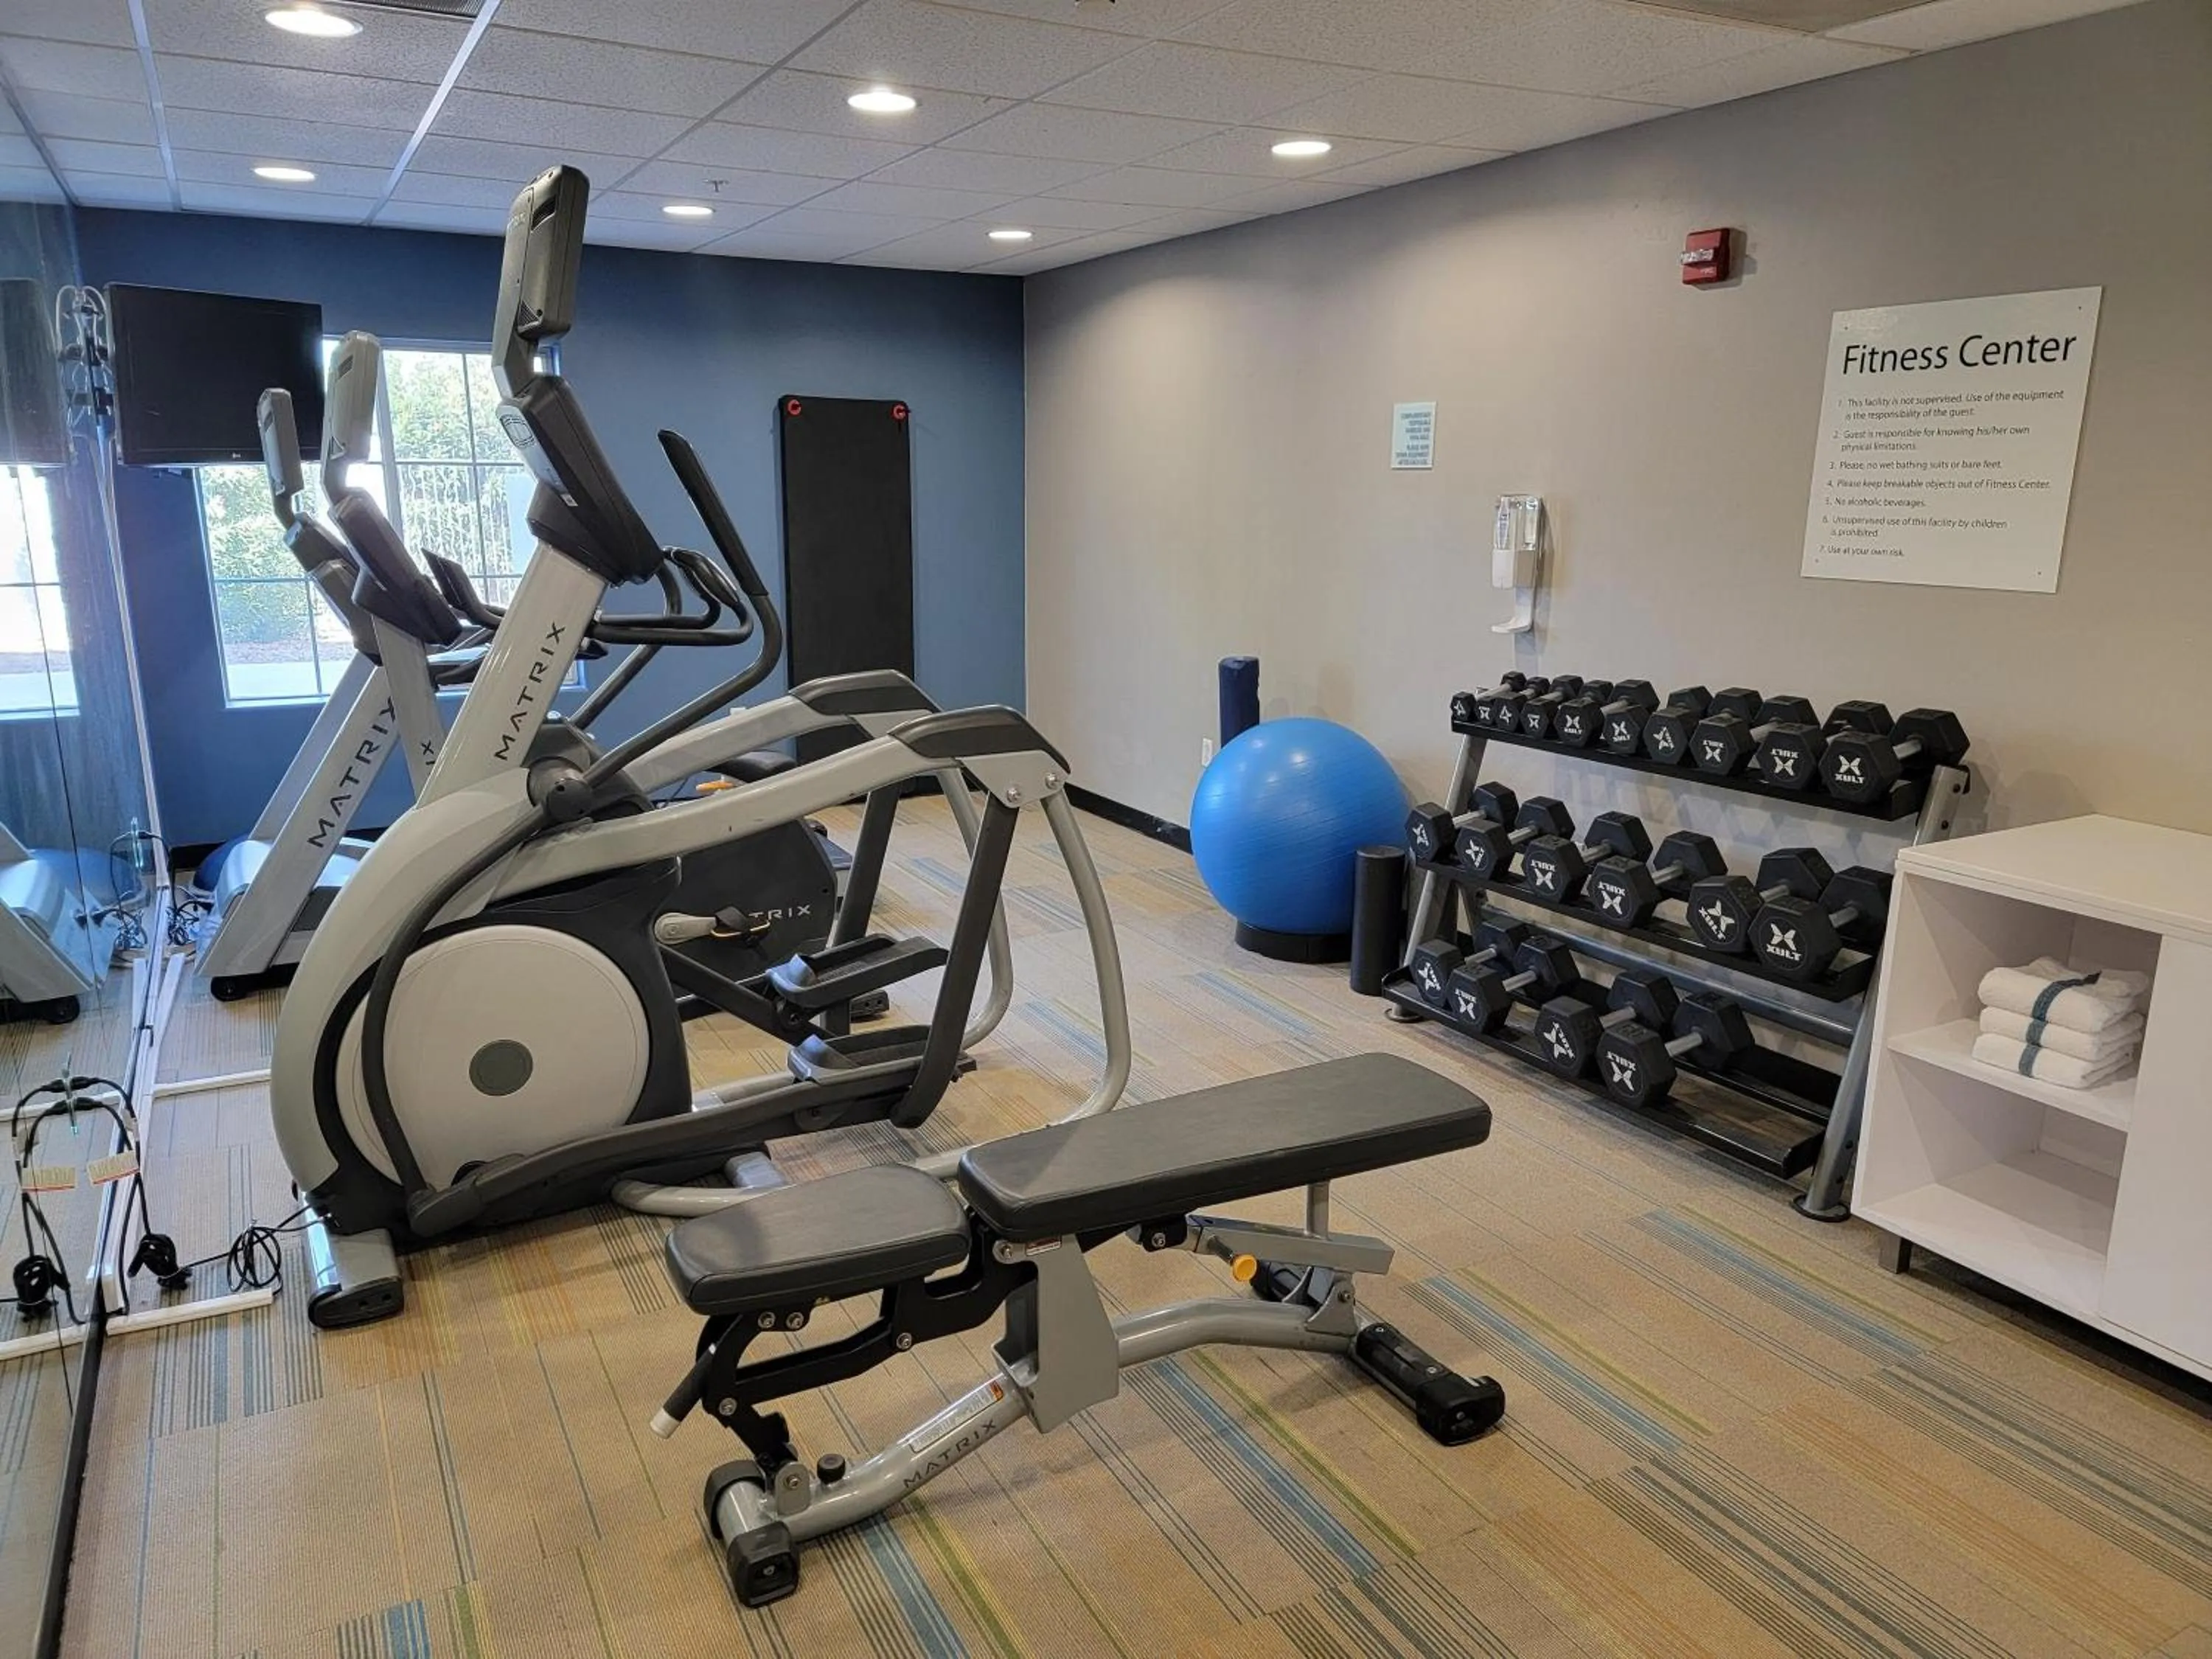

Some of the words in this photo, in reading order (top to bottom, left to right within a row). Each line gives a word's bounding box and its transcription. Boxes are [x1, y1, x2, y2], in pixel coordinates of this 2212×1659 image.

[1843, 344, 1949, 375] Fitness
[1959, 334, 2077, 367] Center
[1865, 397, 1891, 408] facility
[1901, 397, 1914, 405] not
[1966, 393, 1982, 403] Use
[1984, 392, 1994, 403] of
[1996, 392, 2011, 401] the
[2012, 390, 2064, 402] equipment
[1854, 411, 1866, 420] the
[1868, 409, 1920, 421] responsibility
[1922, 408, 1932, 418] of
[1933, 408, 1947, 417] the
[1843, 429, 1866, 439] Guest
[1876, 428, 1922, 439] responsible
[1924, 427, 1934, 437] for
[1937, 426, 1974, 438] knowing
[2010, 427, 2030, 435] own
[1841, 442, 1872, 453] physical
[1840, 460, 1864, 470] Please
[1879, 461, 1895, 470] wet
[1896, 460, 1927, 471] bathing
[1930, 460, 1948, 470] suits
[1961, 459, 1981, 469] bare
[1837, 479, 1862, 488] Please
[1863, 479, 1882, 490] keep
[1884, 479, 1923, 488] breakable
[1925, 479, 1955, 490] objects
[1958, 480, 1972, 489] out
[1975, 479, 1983, 489] of
[1986, 479, 2017, 489] Fitness
[1834, 496, 1846, 507] No
[1848, 497, 1882, 507] alcoholic
[1833, 515, 1885, 526] Unsupervised
[1902, 517, 1911, 526] of
[1912, 516, 1927, 526] this
[1928, 517, 1956, 528] facility
[1958, 518, 1969, 529] by
[1972, 518, 2007, 529] children
[1828, 544, 1841, 554] Use
[1851, 547, 1869, 556] your
[1871, 548, 1889, 556] own
[493, 622, 566, 761] MATRIX
[307, 695, 396, 848] MATRIX
[1834, 773, 1865, 784] XULT
[748, 905, 811, 921] TRIX
[1766, 943, 1803, 961] XULT
[903, 1418, 997, 1489] MATRIX
